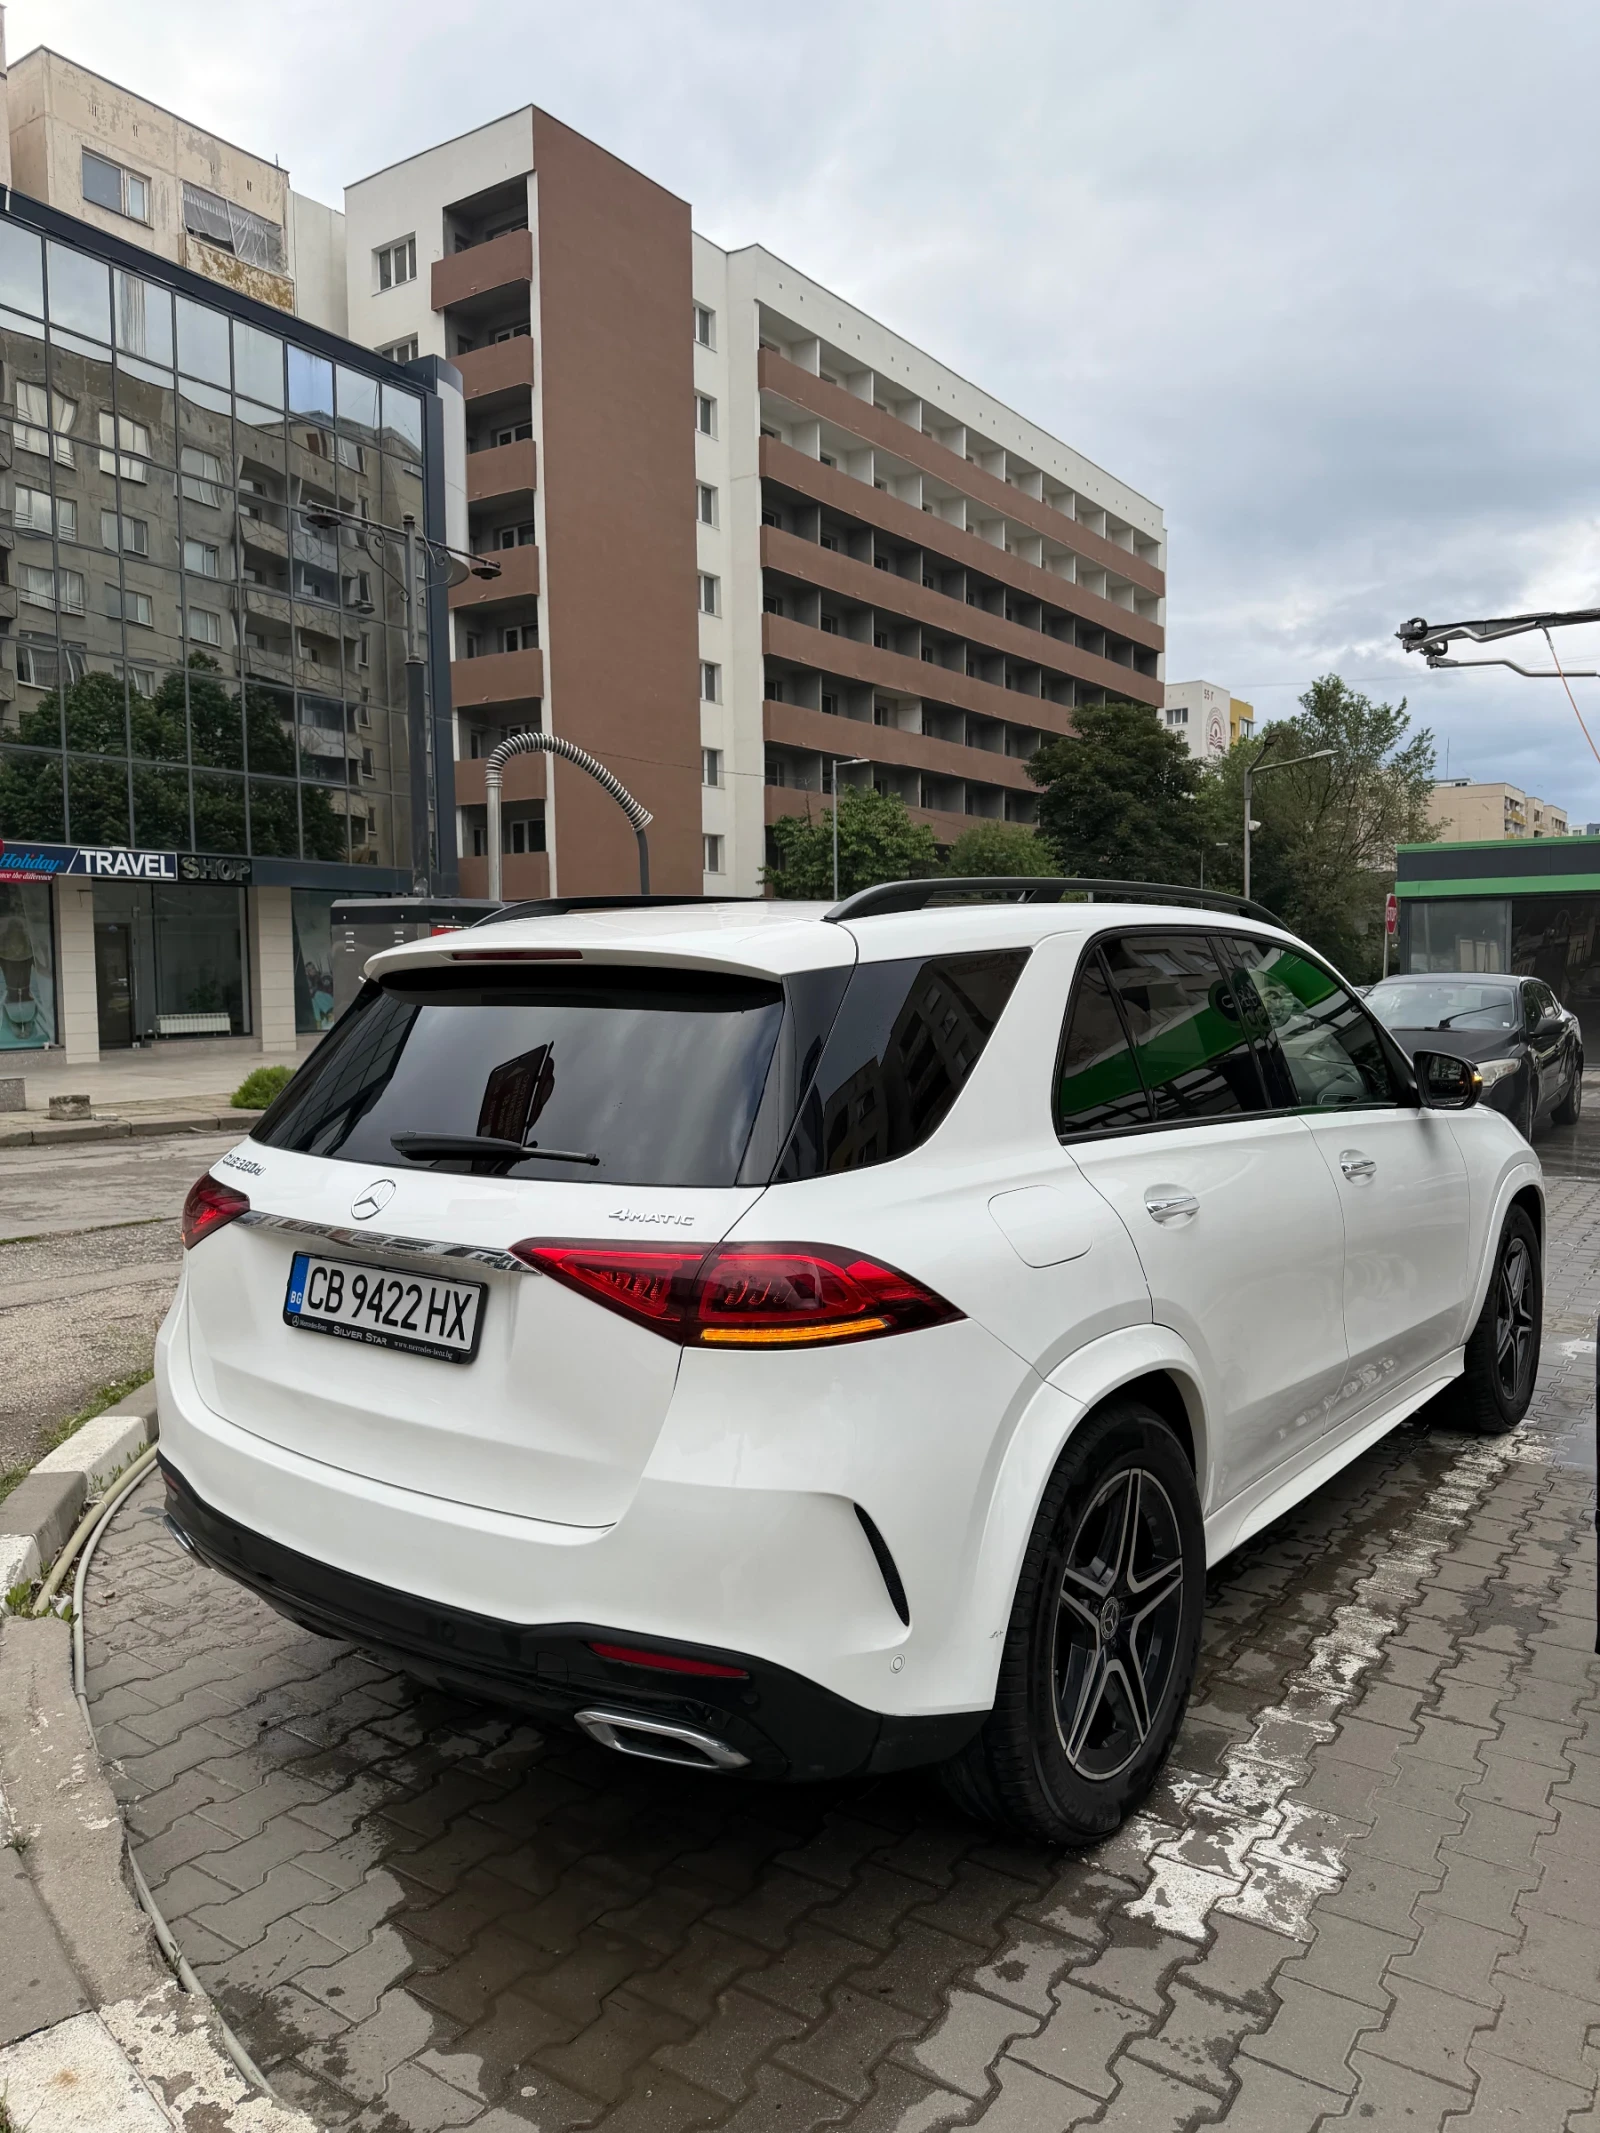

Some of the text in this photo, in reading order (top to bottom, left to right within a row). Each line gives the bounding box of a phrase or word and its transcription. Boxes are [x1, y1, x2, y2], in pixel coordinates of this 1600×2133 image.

[0, 852, 60, 873] Holiday
[79, 849, 251, 881] TRAVEL SHOP
[22, 872, 53, 881] difference
[608, 1207, 695, 1226] 4MATIC
[290, 1290, 302, 1305] BG
[307, 1266, 473, 1341] CB 9422 HX
